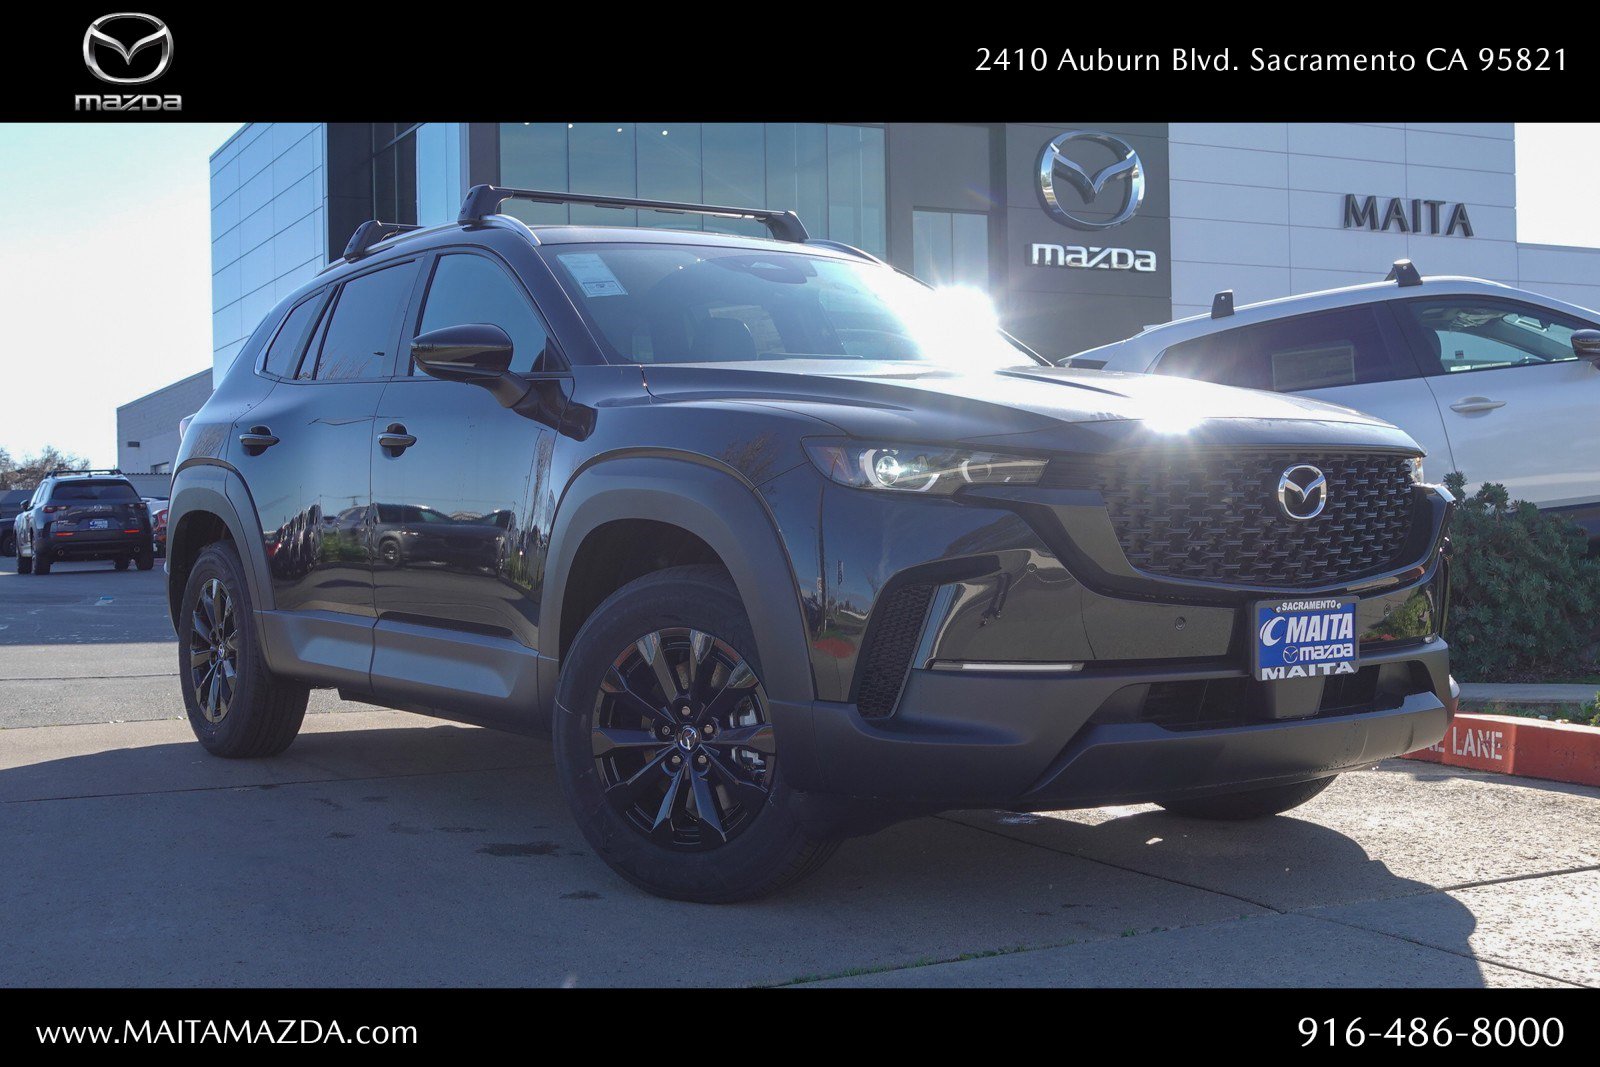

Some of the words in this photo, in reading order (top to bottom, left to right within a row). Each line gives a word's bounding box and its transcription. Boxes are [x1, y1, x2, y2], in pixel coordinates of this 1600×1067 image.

[1344, 193, 1475, 238] MAITA
[1281, 600, 1337, 611] SACRAMENTO
[1285, 612, 1353, 643] MAITA
[1261, 661, 1355, 681] MAITA
[1452, 726, 1503, 760] LANE
